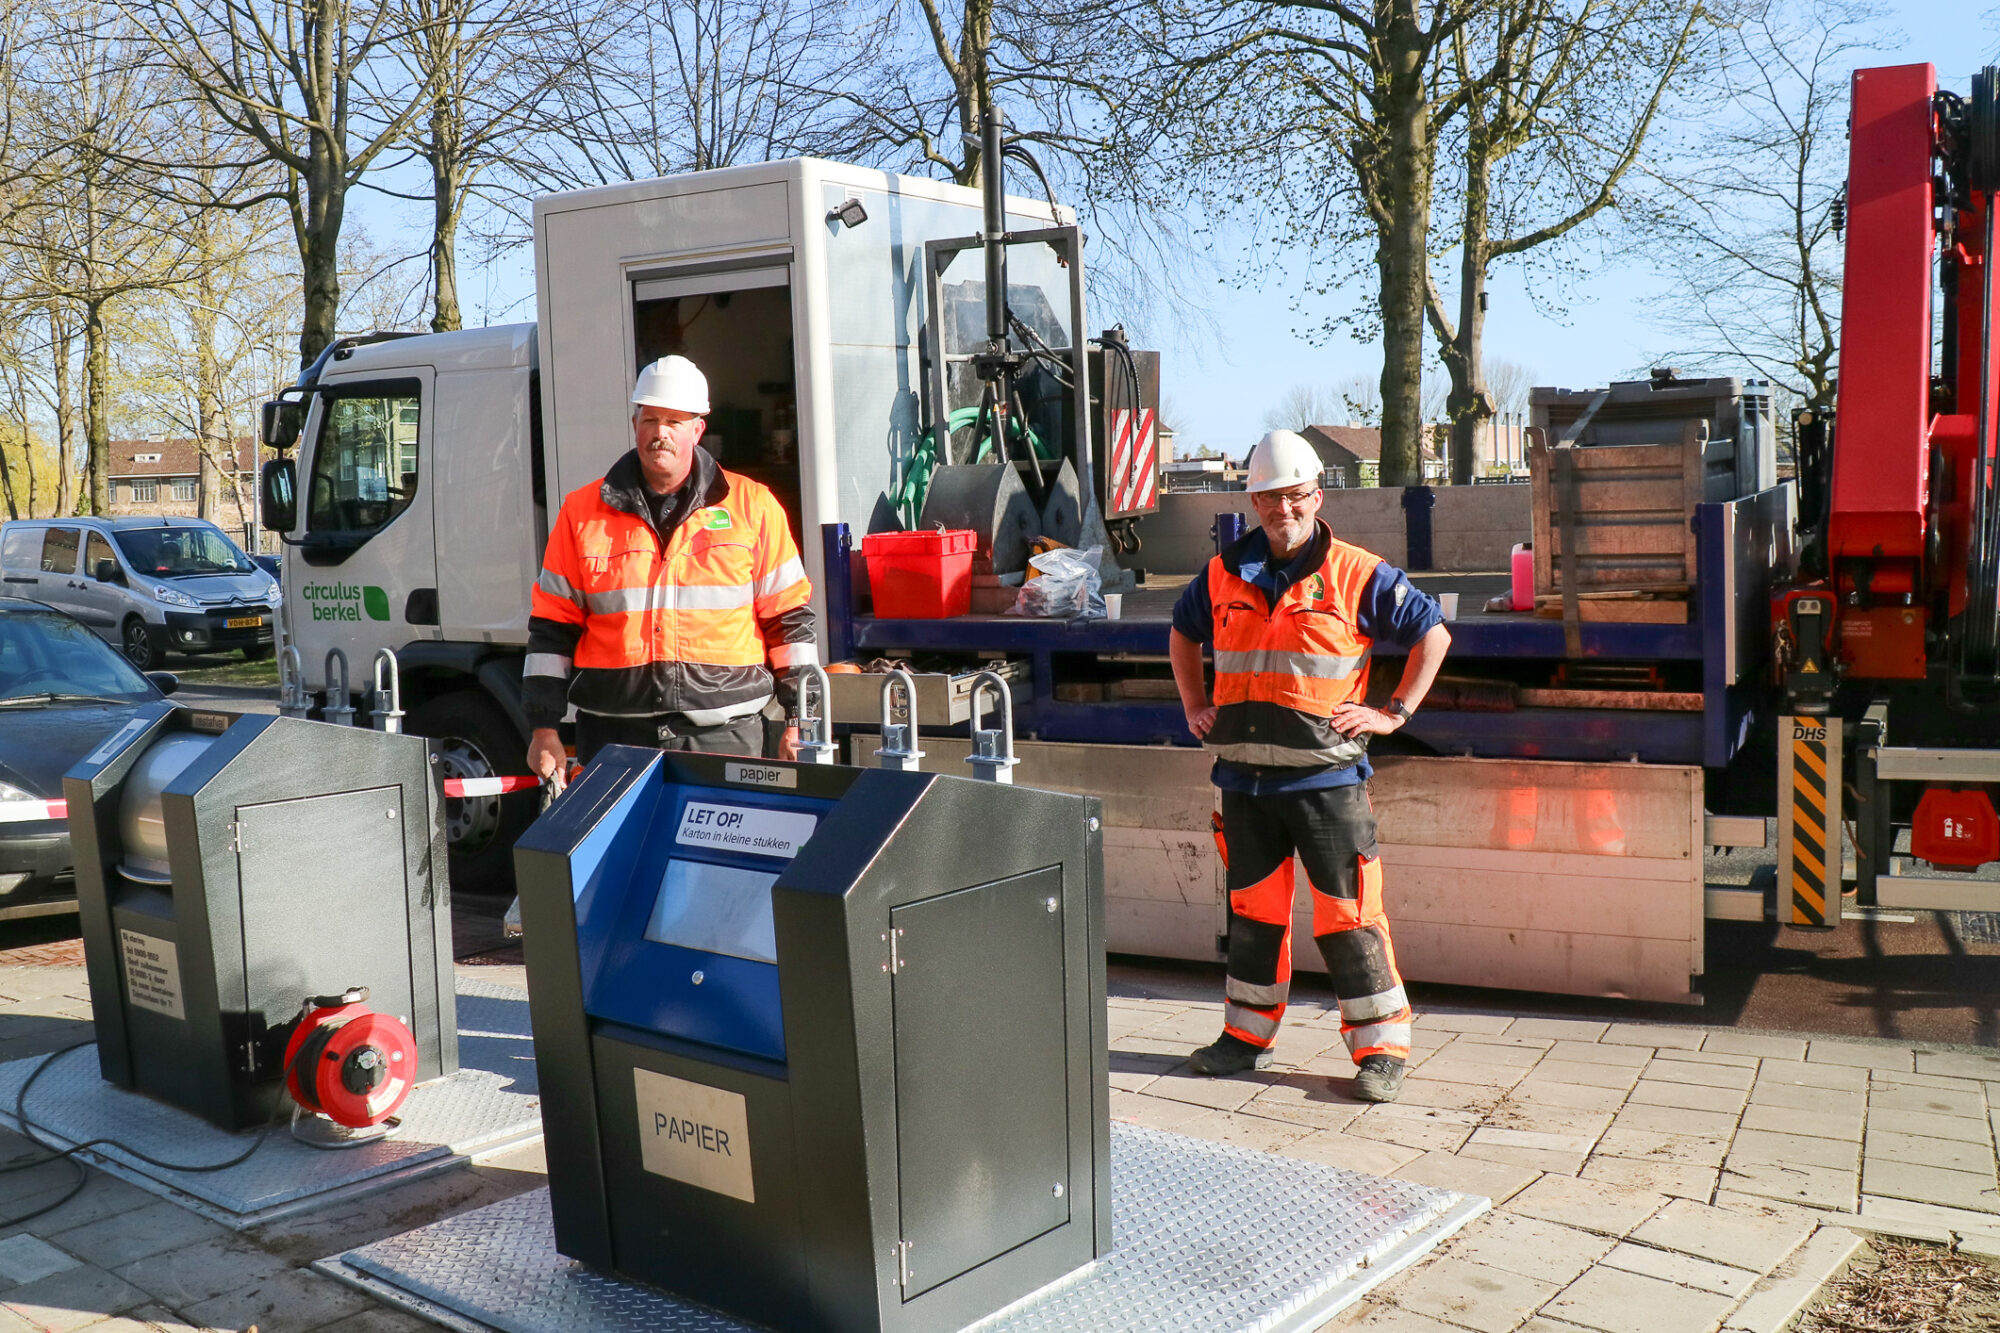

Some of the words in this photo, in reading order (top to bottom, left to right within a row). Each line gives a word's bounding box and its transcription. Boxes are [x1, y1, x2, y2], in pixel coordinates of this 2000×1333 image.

[302, 580, 361, 600] circulus
[312, 602, 362, 621] berkel
[1792, 727, 1827, 740] DHS
[740, 768, 781, 783] papier
[687, 808, 715, 824] LET
[716, 812, 744, 829] OP!
[682, 827, 711, 841] Karton
[712, 830, 722, 841] in
[723, 831, 751, 846] kleine
[753, 837, 790, 850] stukken
[655, 1112, 731, 1157] PAPIER
